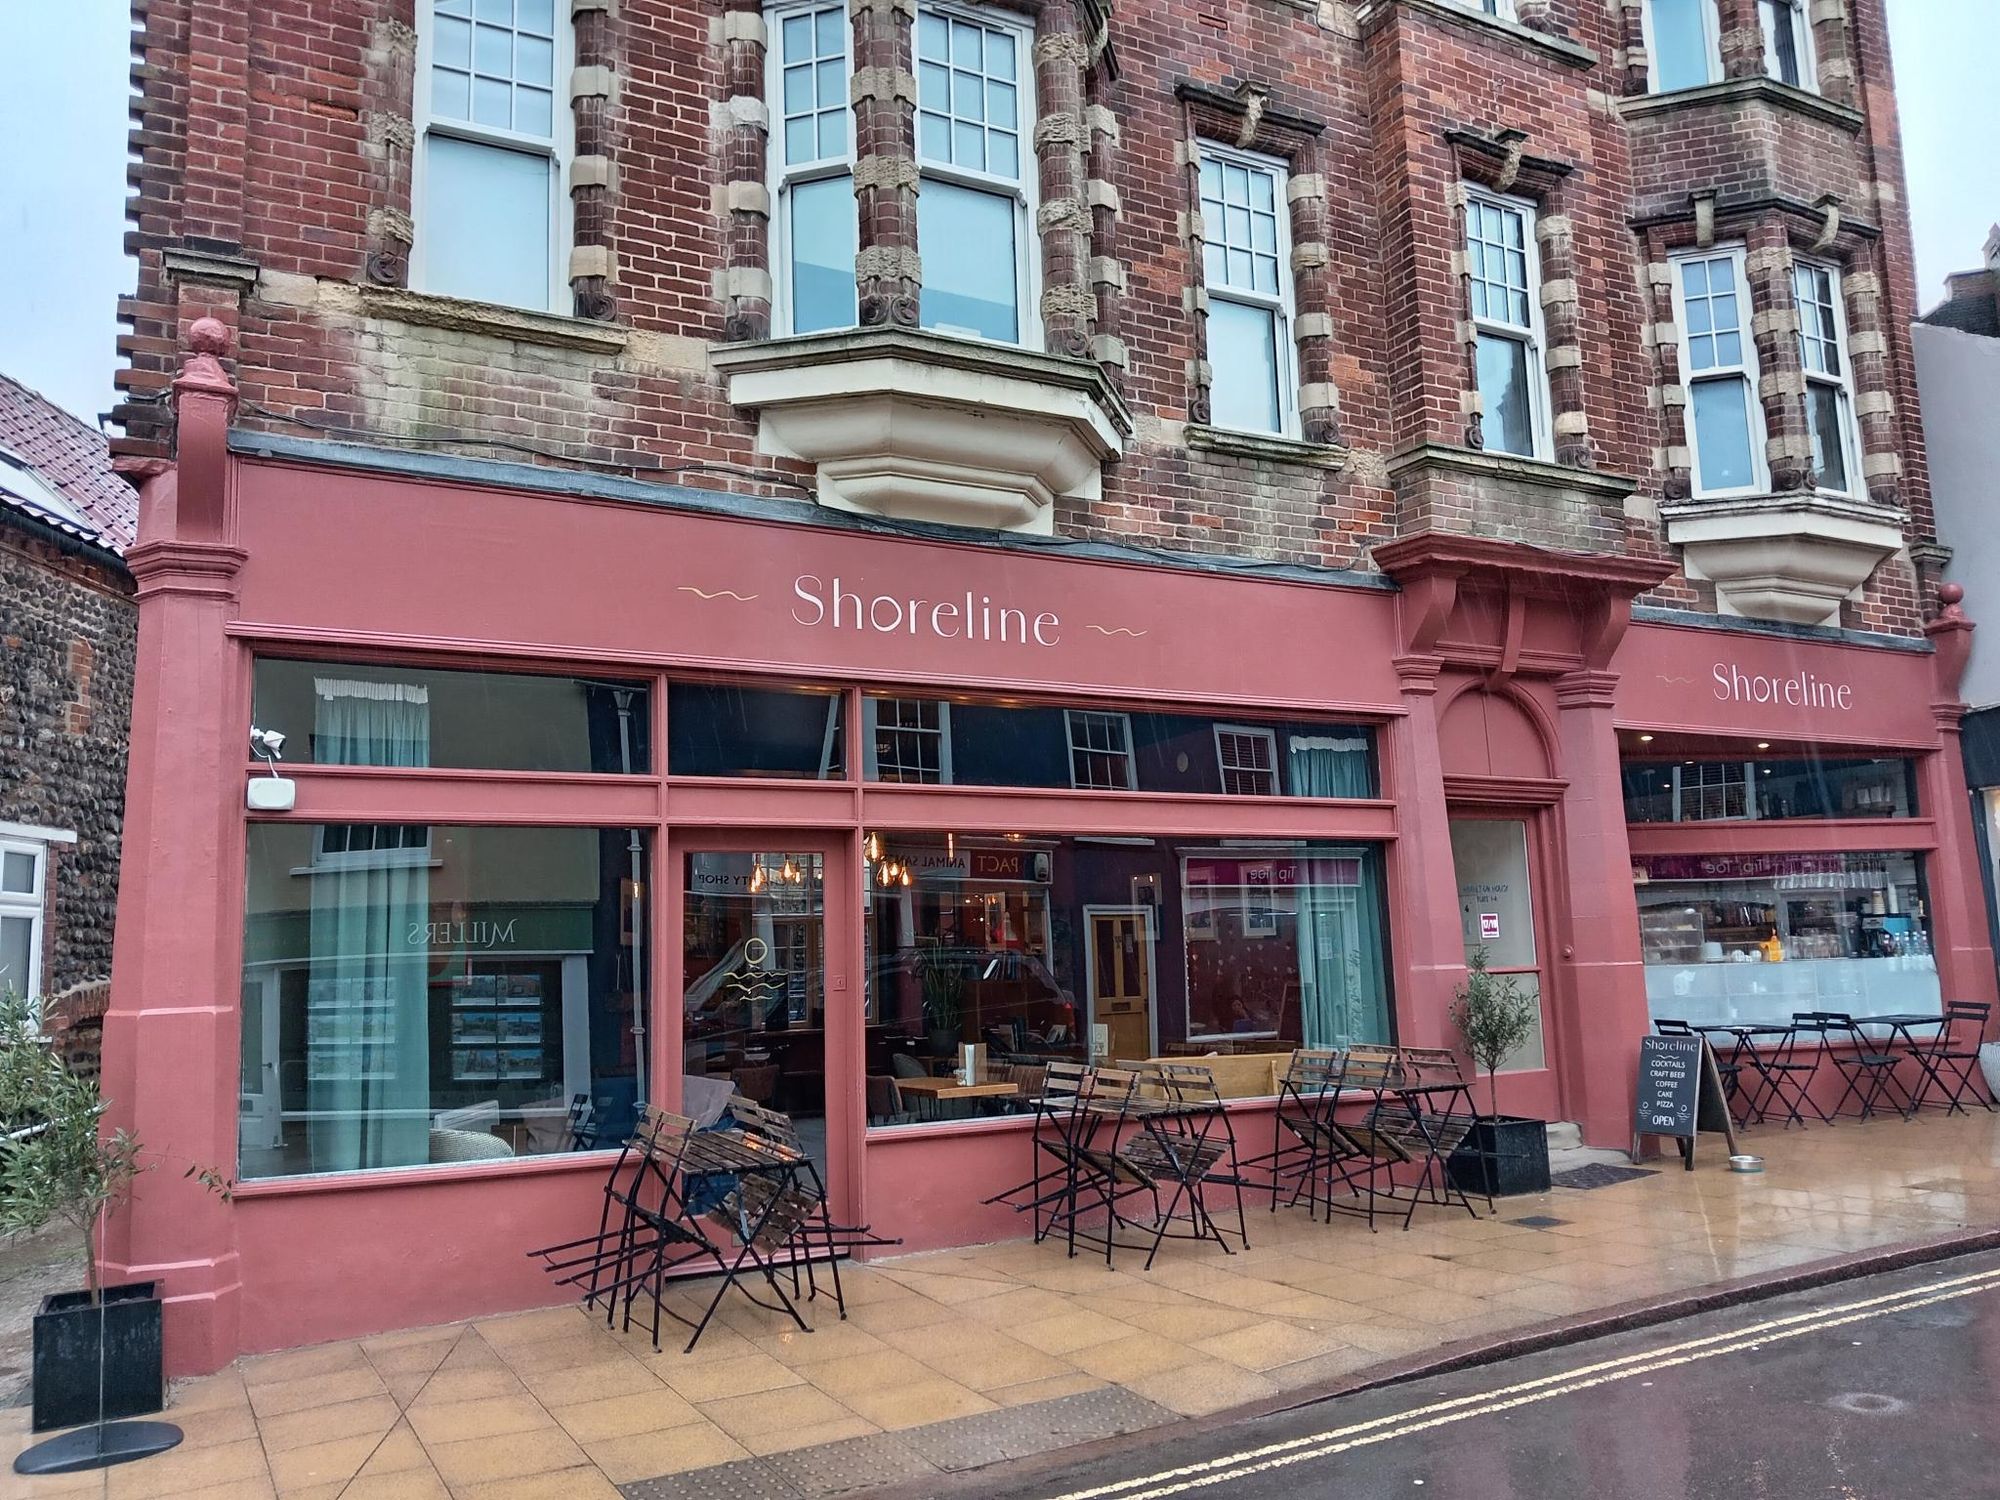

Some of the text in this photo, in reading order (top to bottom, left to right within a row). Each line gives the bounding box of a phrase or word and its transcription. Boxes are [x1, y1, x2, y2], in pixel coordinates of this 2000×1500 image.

[791, 574, 1060, 647] Shoreline
[1713, 662, 1853, 710] Shoreline
[1645, 1039, 1697, 1052] Shoreline
[1651, 1060, 1685, 1069] COCKTAILS
[1655, 1080, 1678, 1088] COFFEE
[1657, 1090, 1673, 1098] CAKE
[1652, 1115, 1675, 1126] OPEN
